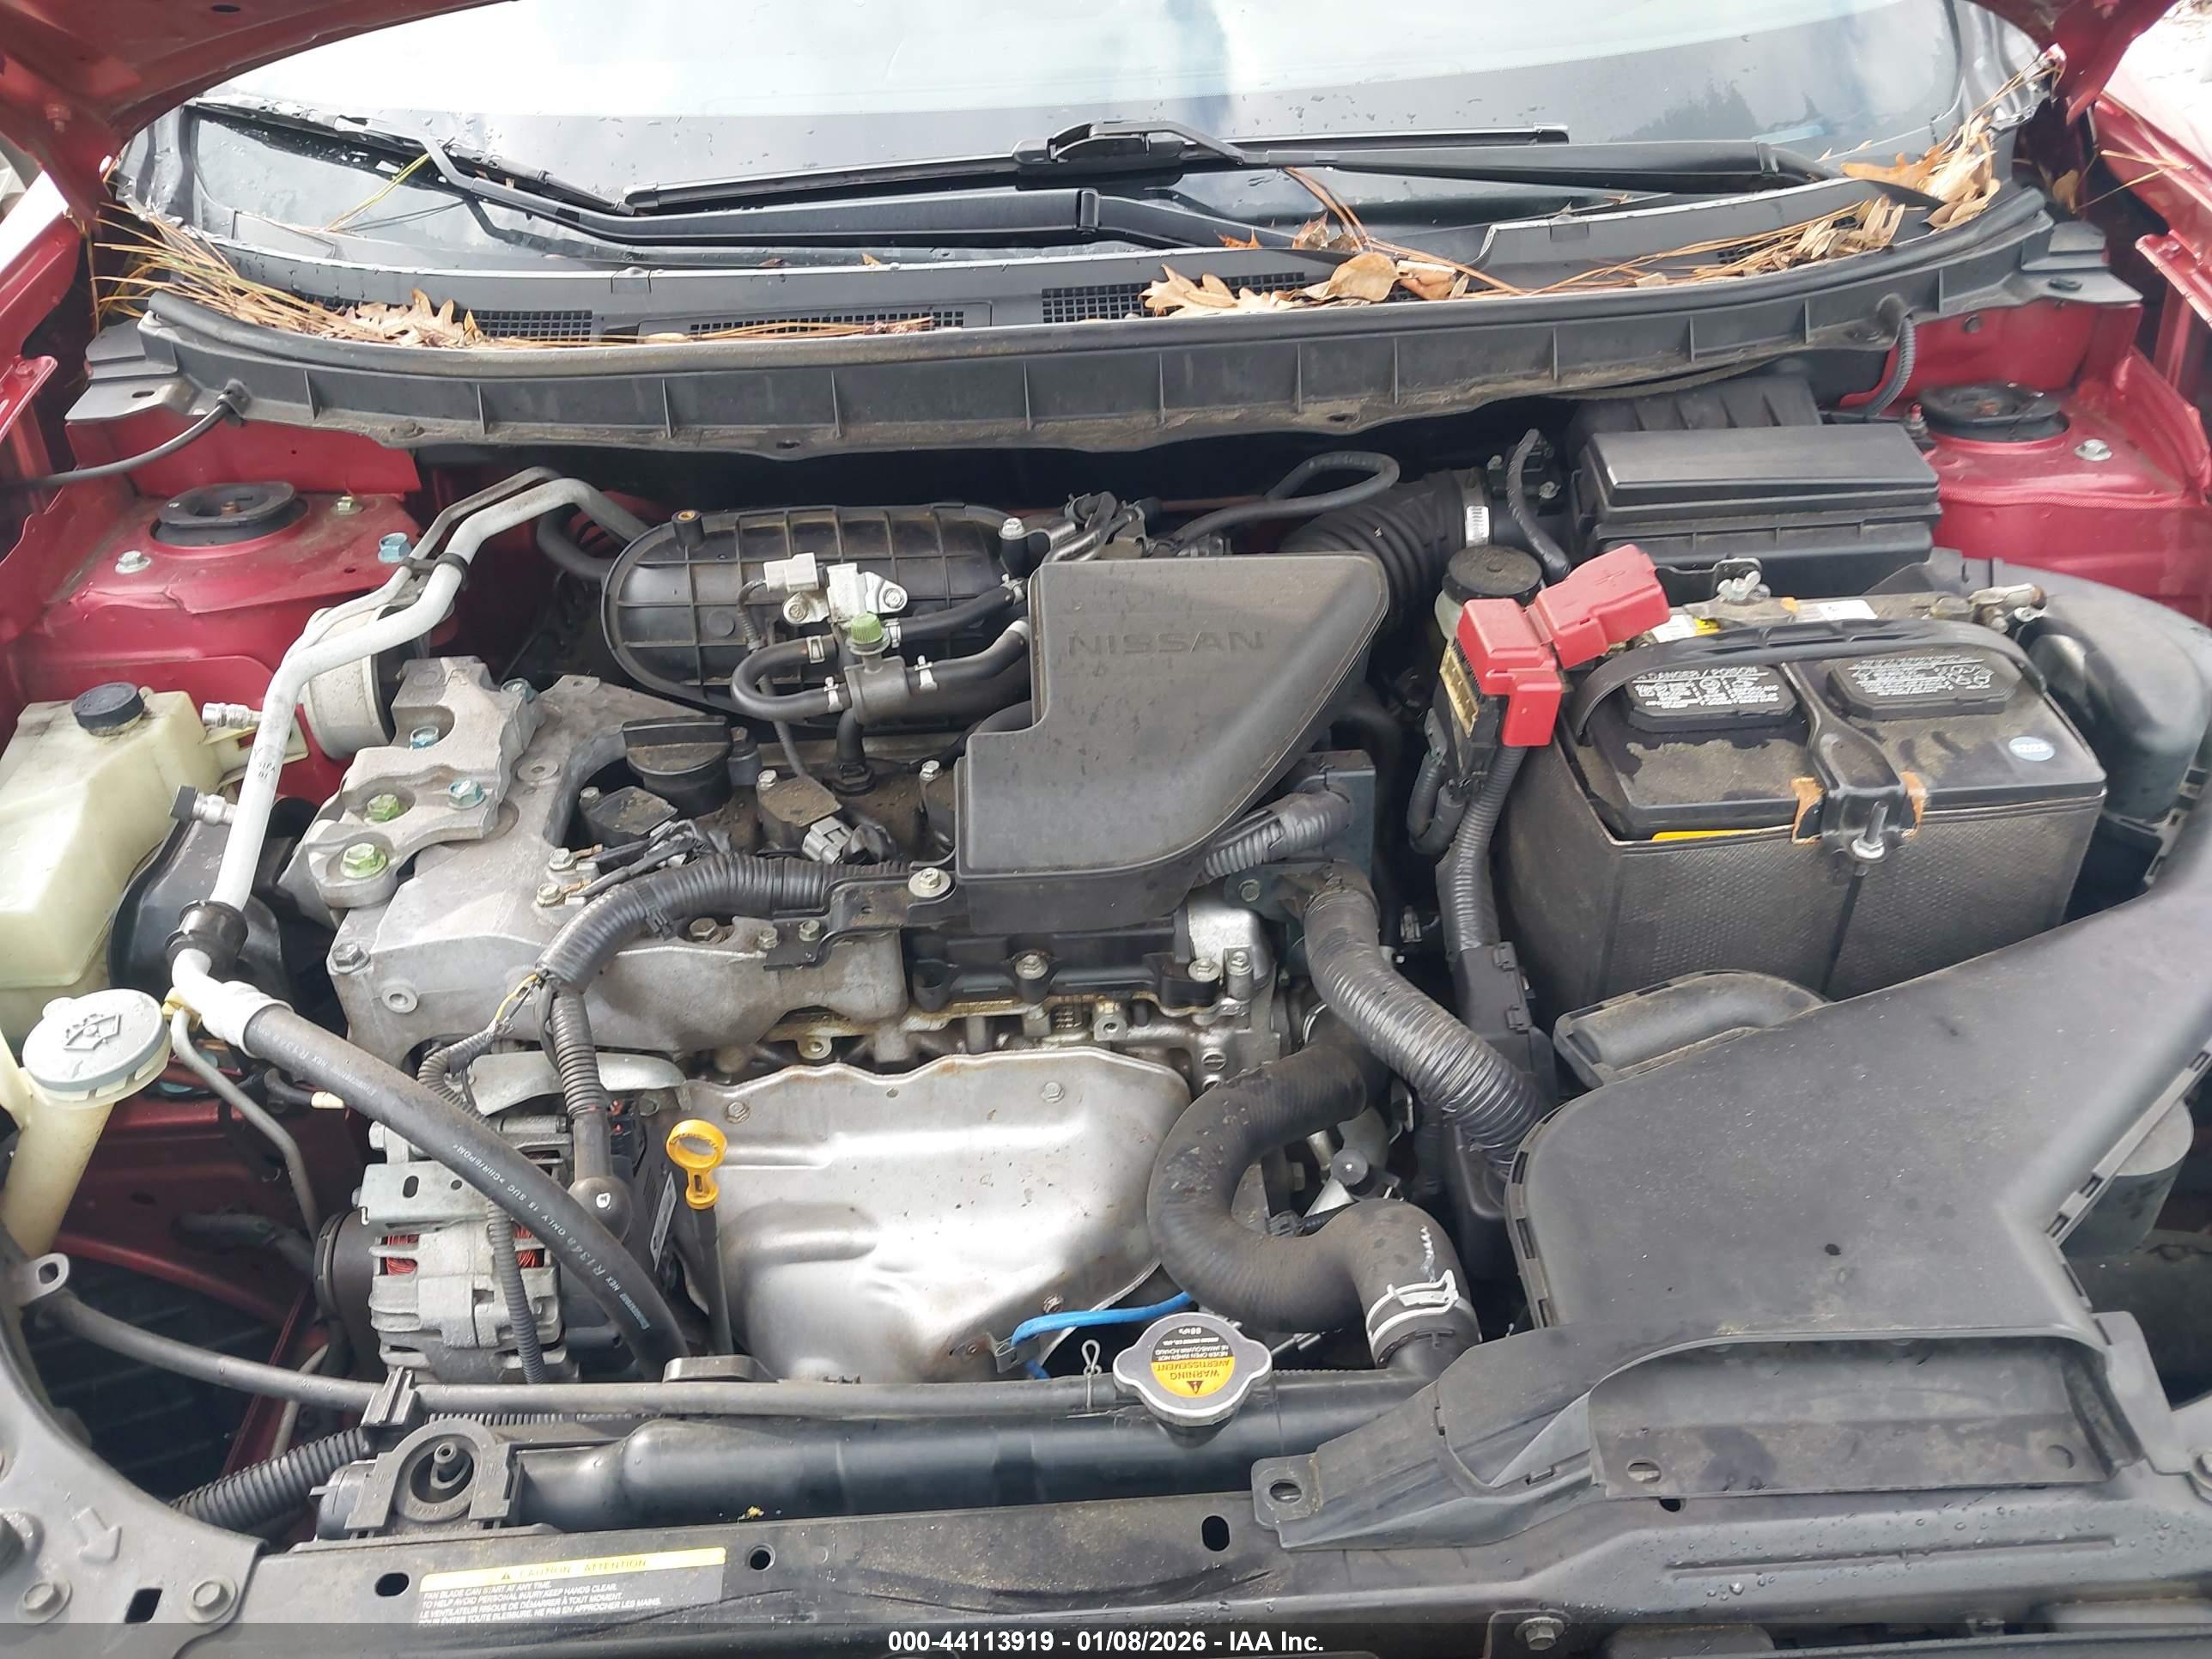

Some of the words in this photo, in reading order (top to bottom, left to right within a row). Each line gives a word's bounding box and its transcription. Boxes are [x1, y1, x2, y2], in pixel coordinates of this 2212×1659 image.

[1067, 630, 1266, 658] NISSAN
[541, 1214, 567, 1237] ONLY
[567, 1237, 606, 1277] R134a
[1157, 1359, 1231, 1371] AVERTISSEMENT
[1170, 1369, 1220, 1381] WARNING
[520, 1565, 571, 1577] CAUTION
[585, 1559, 647, 1571] ATTENTION
[422, 1600, 434, 1609] TO
[434, 1598, 454, 1608] HELP
[453, 1596, 477, 1607] AVOID
[477, 1593, 517, 1605] PERSONAL
[564, 1585, 591, 1595] HANDS
[424, 1592, 440, 1601] FAN
[440, 1589, 465, 1599] BLADE
[465, 1587, 482, 1596] CAN
[482, 1583, 507, 1595] START
[507, 1583, 517, 1593] AT
[516, 1582, 533, 1592] ANY
[419, 1611, 430, 1620] LE
[430, 1607, 478, 1619] VENTILATEUR
[478, 1603, 507, 1614] RISQUE
[507, 1601, 520, 1611] DE
[520, 1597, 562, 1611] DÉMARRER
[568, 1594, 588, 1604] TOUT
[588, 1592, 623, 1603] MOMENT.
[467, 1613, 491, 1624] TOUTE
[533, 1607, 545, 1617] NE
[545, 1606, 562, 1616] PAS
[562, 1605, 574, 1614] EN
[573, 1601, 621, 1613] APPROCHER
[622, 1600, 636, 1609] LES
